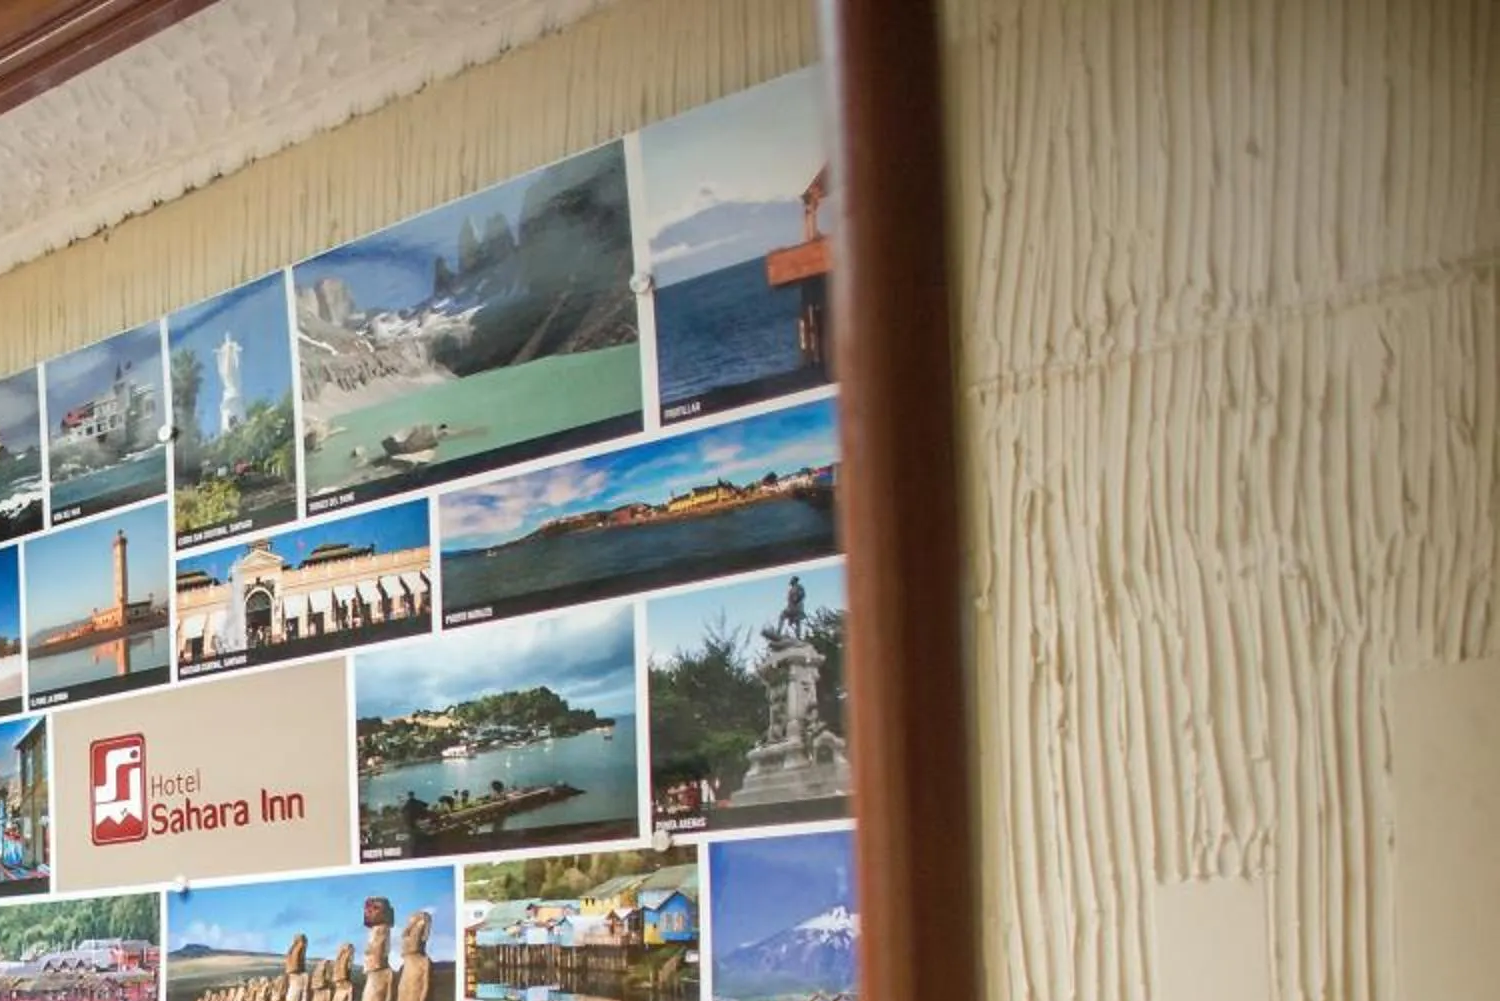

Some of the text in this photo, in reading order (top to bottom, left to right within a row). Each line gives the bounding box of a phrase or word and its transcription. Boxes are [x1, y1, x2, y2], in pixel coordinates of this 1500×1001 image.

[151, 768, 201, 798] Hotel
[151, 788, 305, 836] Sahara Inn
